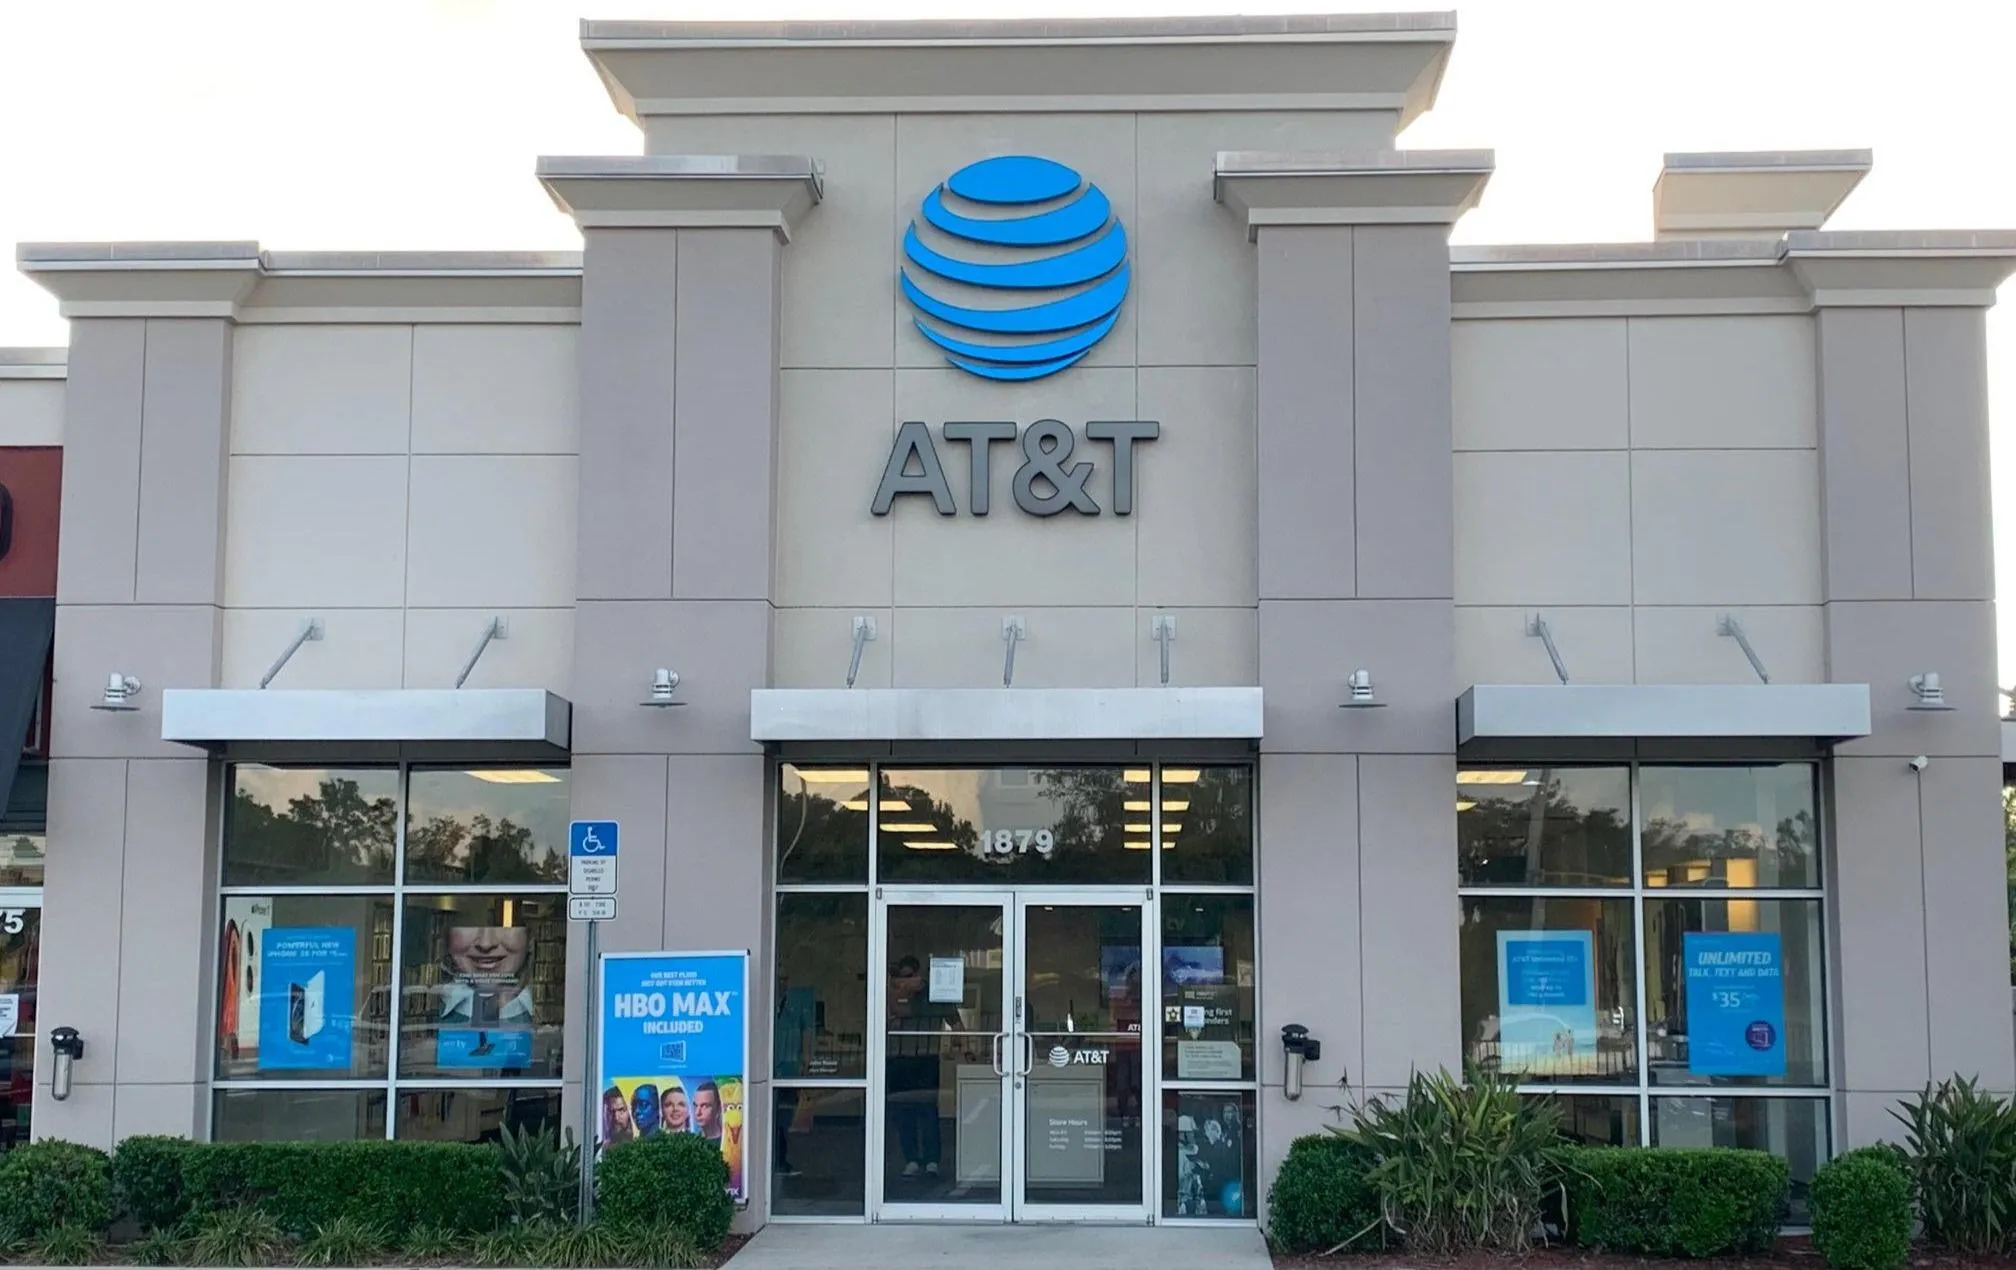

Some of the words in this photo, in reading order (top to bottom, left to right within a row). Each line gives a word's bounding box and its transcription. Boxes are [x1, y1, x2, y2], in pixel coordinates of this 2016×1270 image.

[871, 419, 1160, 516] AT&T
[980, 829, 1054, 853] 1879
[1698, 951, 1771, 965] UNLIMITED
[1714, 967, 1737, 977] TEXT
[1757, 967, 1780, 977] DATA
[614, 993, 666, 1018] HBO
[673, 991, 732, 1017] MAX
[643, 1020, 703, 1034] INCLUDED
[1074, 1050, 1110, 1064] AT&T
